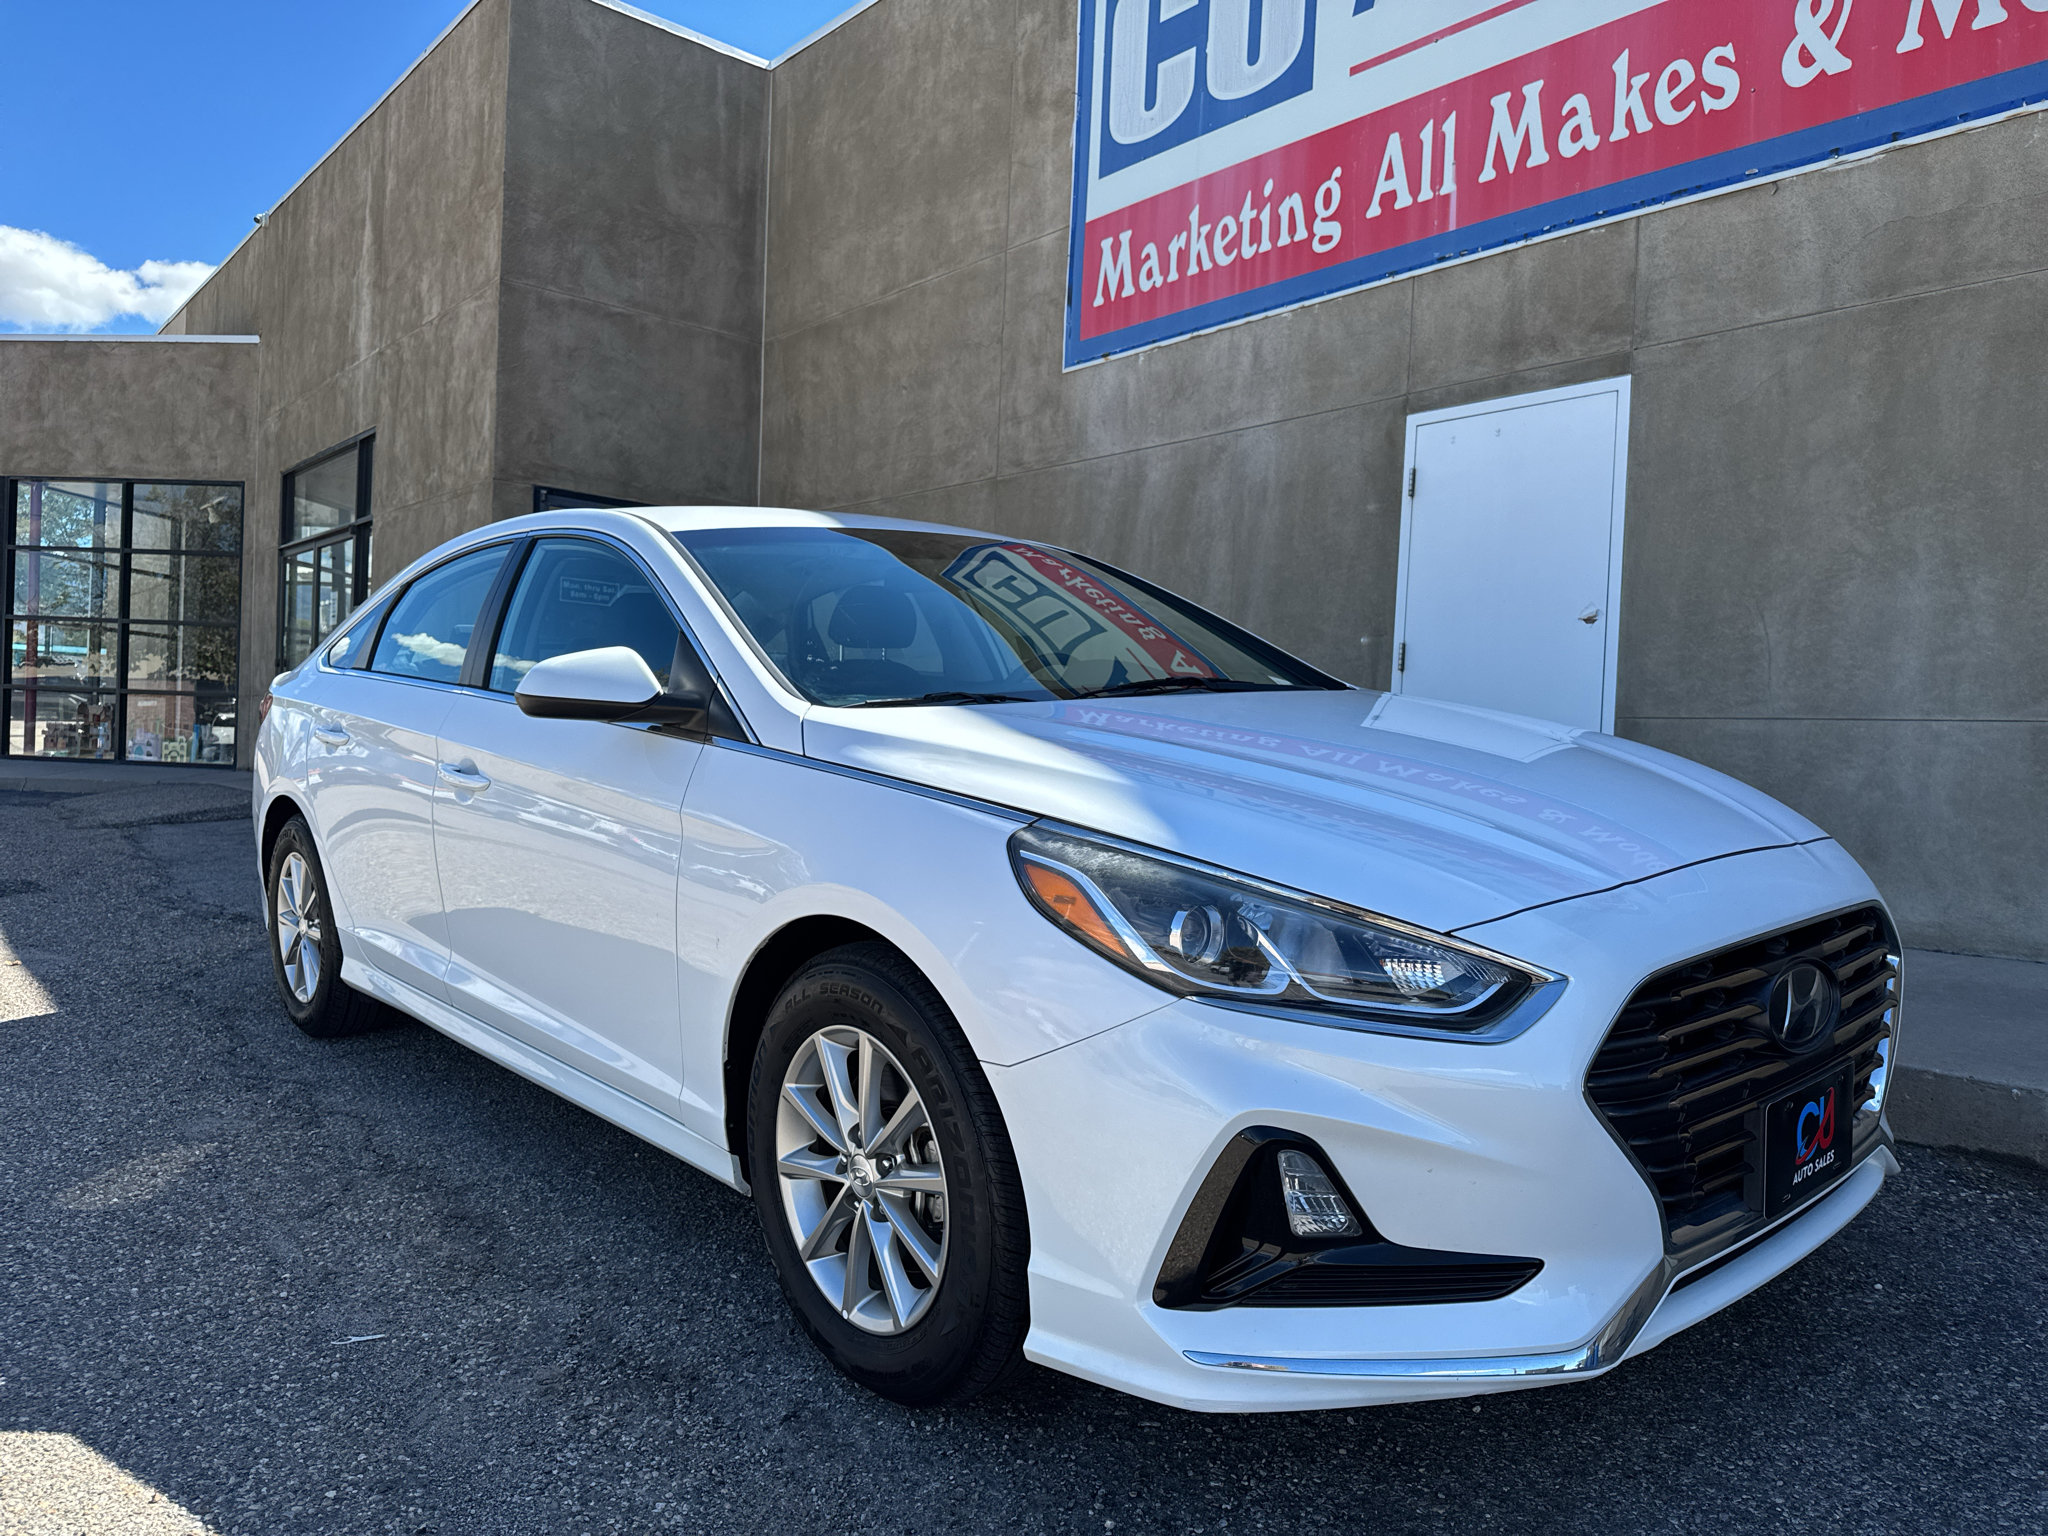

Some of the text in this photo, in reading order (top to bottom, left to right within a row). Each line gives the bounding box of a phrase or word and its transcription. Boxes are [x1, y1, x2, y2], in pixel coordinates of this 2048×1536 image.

[1093, 166, 1341, 307] Marketing
[1366, 110, 1457, 218] All
[1478, 42, 1740, 183] Makes
[1782, 0, 1852, 87] &
[783, 982, 885, 1016] ALL SEASON
[1792, 1150, 1835, 1186] AUTO SALES
